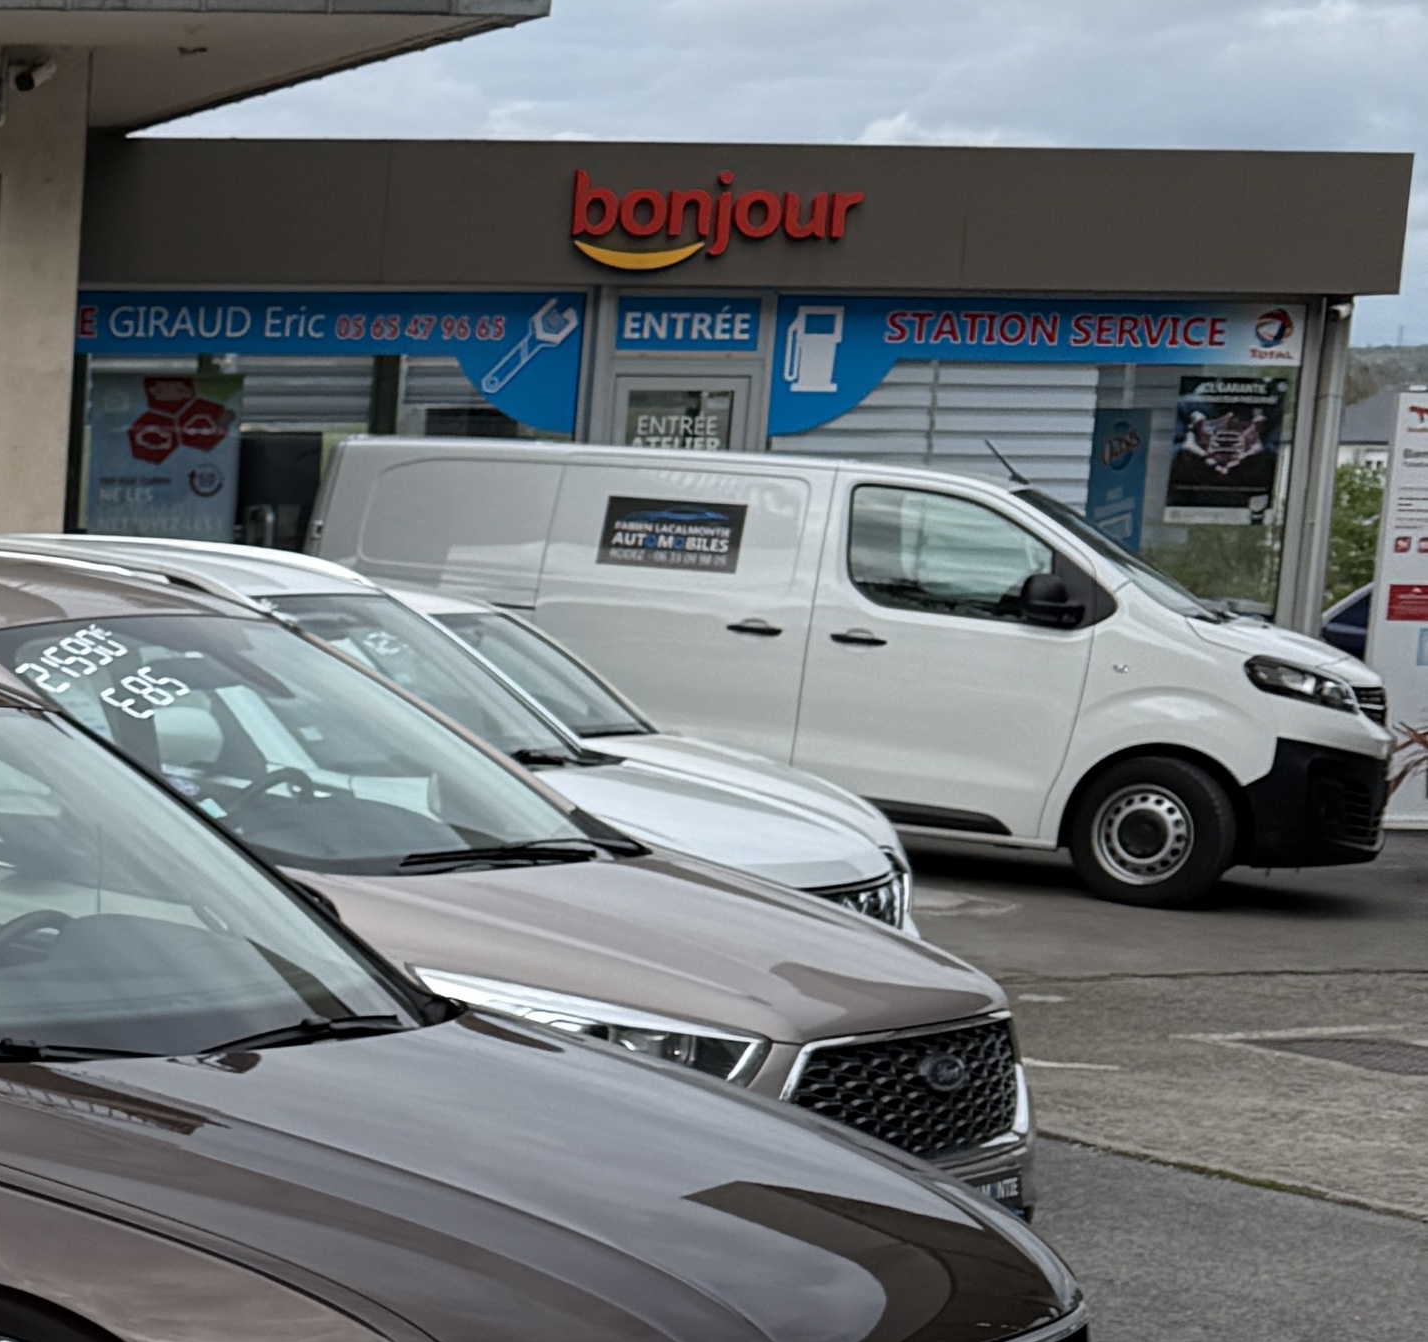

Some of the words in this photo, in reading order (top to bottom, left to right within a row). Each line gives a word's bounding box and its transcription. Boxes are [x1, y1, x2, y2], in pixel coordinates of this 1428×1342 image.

[571, 169, 865, 257] bonjour
[109, 305, 252, 339] GIRAUD
[263, 307, 326, 339] Eric
[623, 305, 751, 340] ENTRÉE
[883, 310, 1059, 347] STATION
[1070, 313, 1228, 349] SERVICE
[611, 532, 729, 553] AUTOMOBILES
[100, 666, 191, 719] E85
